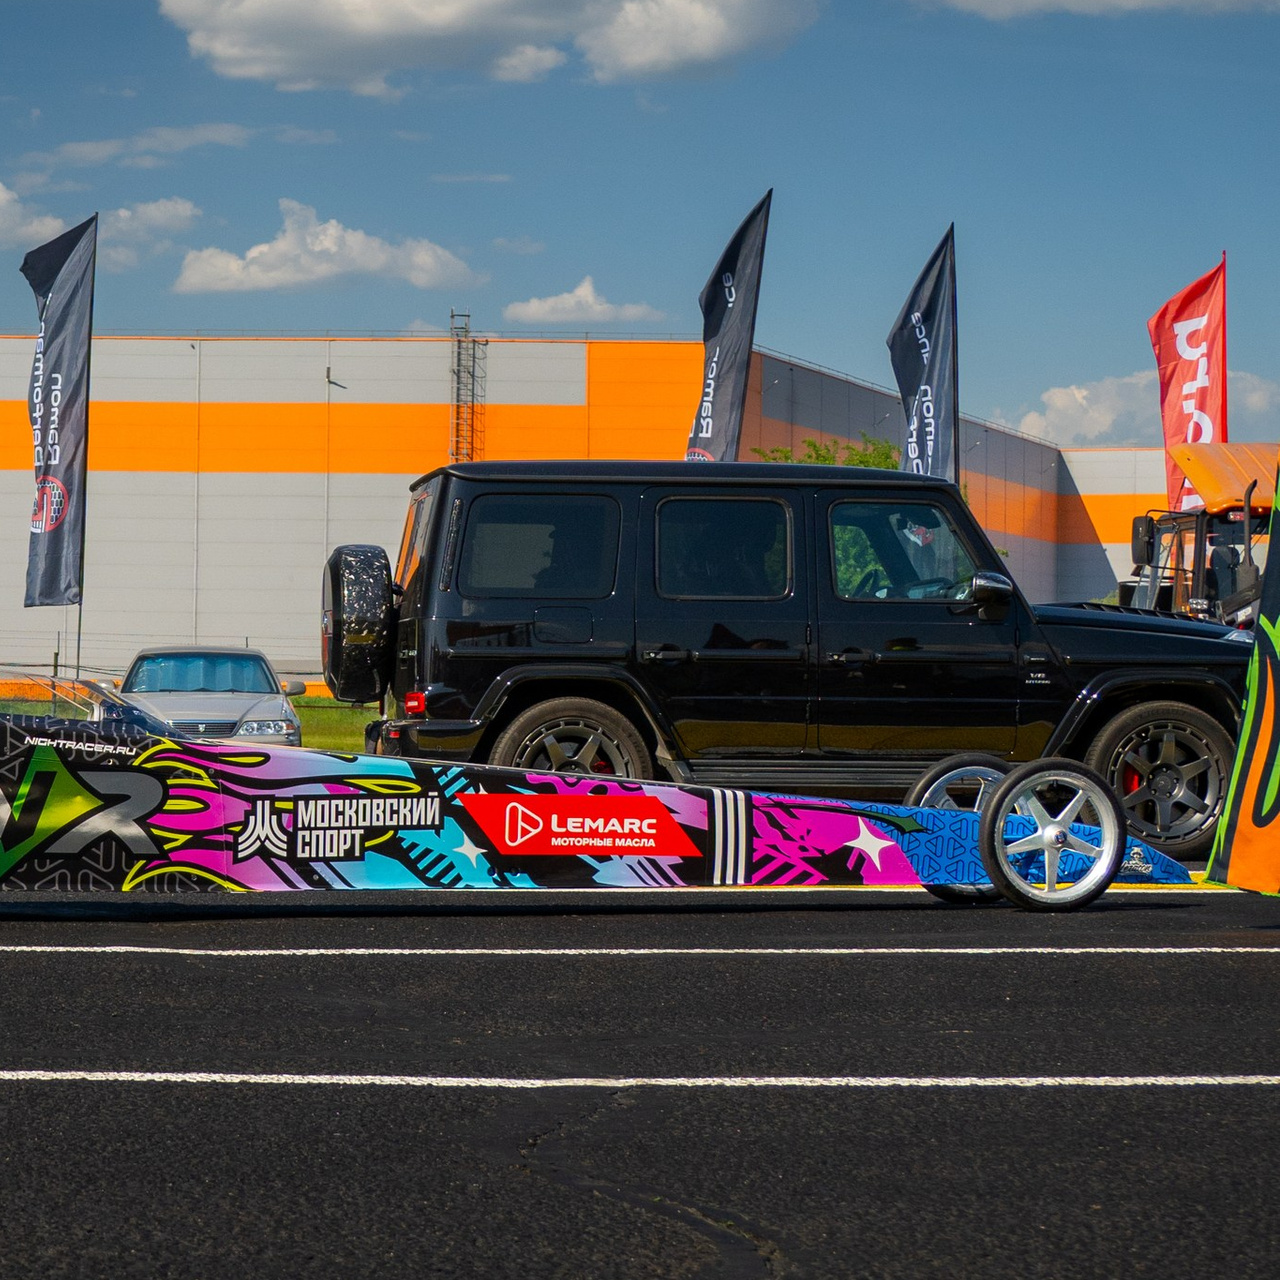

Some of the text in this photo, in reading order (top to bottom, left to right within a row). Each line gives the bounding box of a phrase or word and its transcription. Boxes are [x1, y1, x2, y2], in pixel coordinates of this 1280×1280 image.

[24, 736, 137, 756] NIGHTRACER.RU
[297, 791, 440, 828] МОСКОВСКИЙ
[551, 814, 657, 834] LEMARC
[297, 829, 364, 858] СПОРТ
[551, 837, 656, 847] МОТОРНЫЕ МАСЛА
